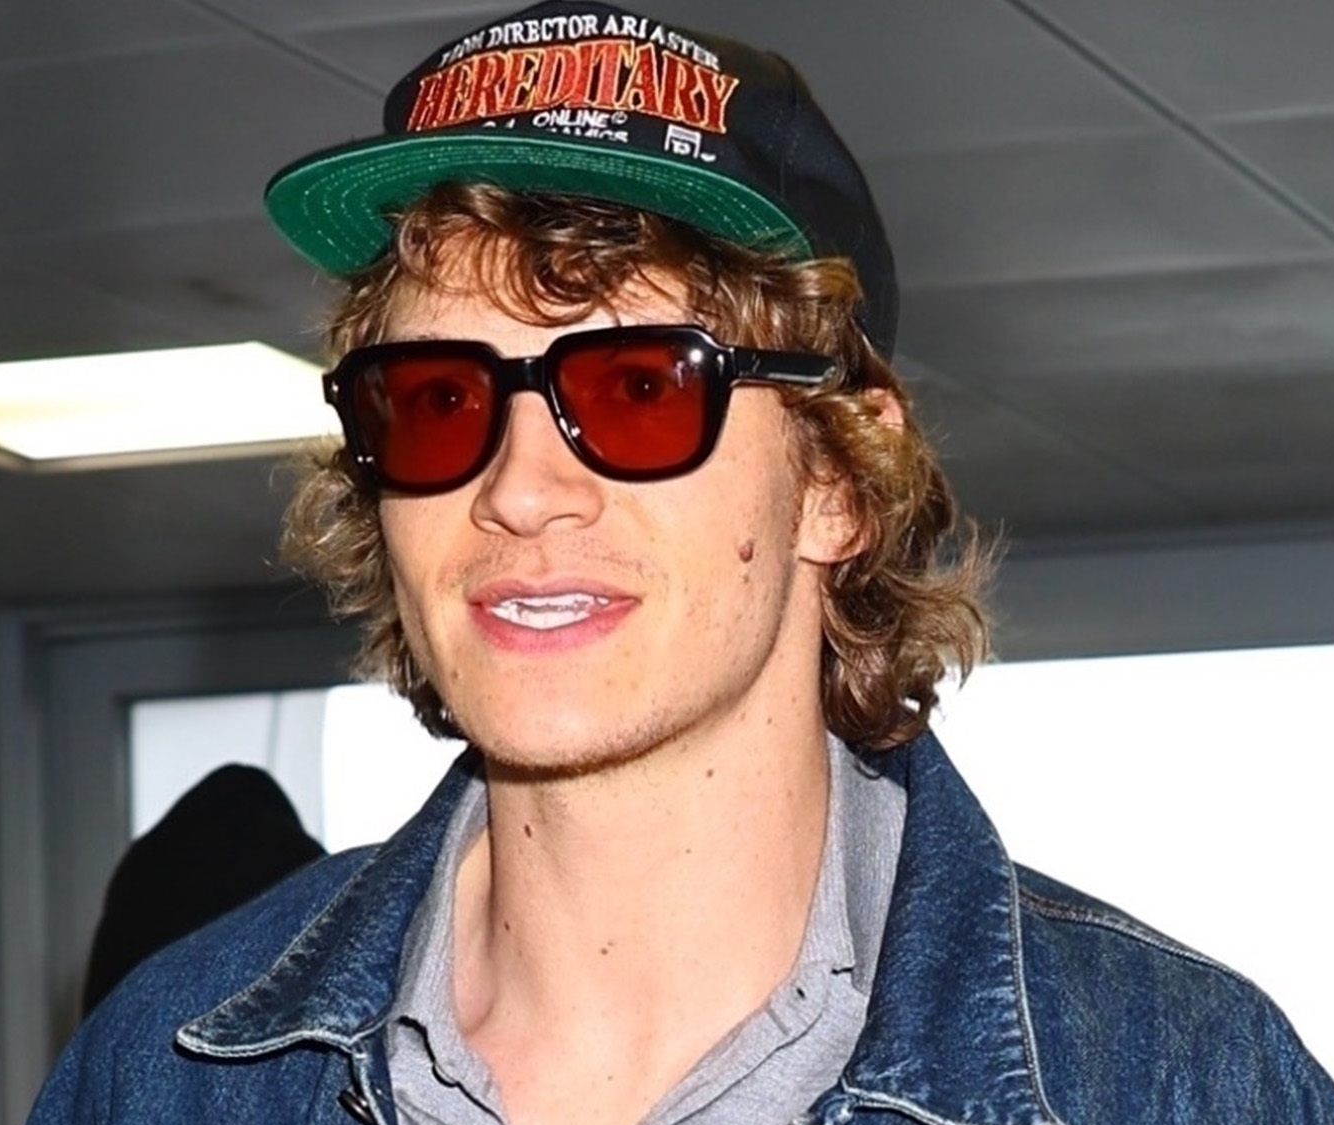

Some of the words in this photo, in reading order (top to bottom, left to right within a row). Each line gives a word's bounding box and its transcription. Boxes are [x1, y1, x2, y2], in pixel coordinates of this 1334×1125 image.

[486, 14, 598, 48] DIRECTOR
[603, 14, 649, 39] ARI
[650, 25, 720, 71] ASTER
[407, 39, 739, 134] HEREDITARY
[532, 109, 610, 128] ONLINE
